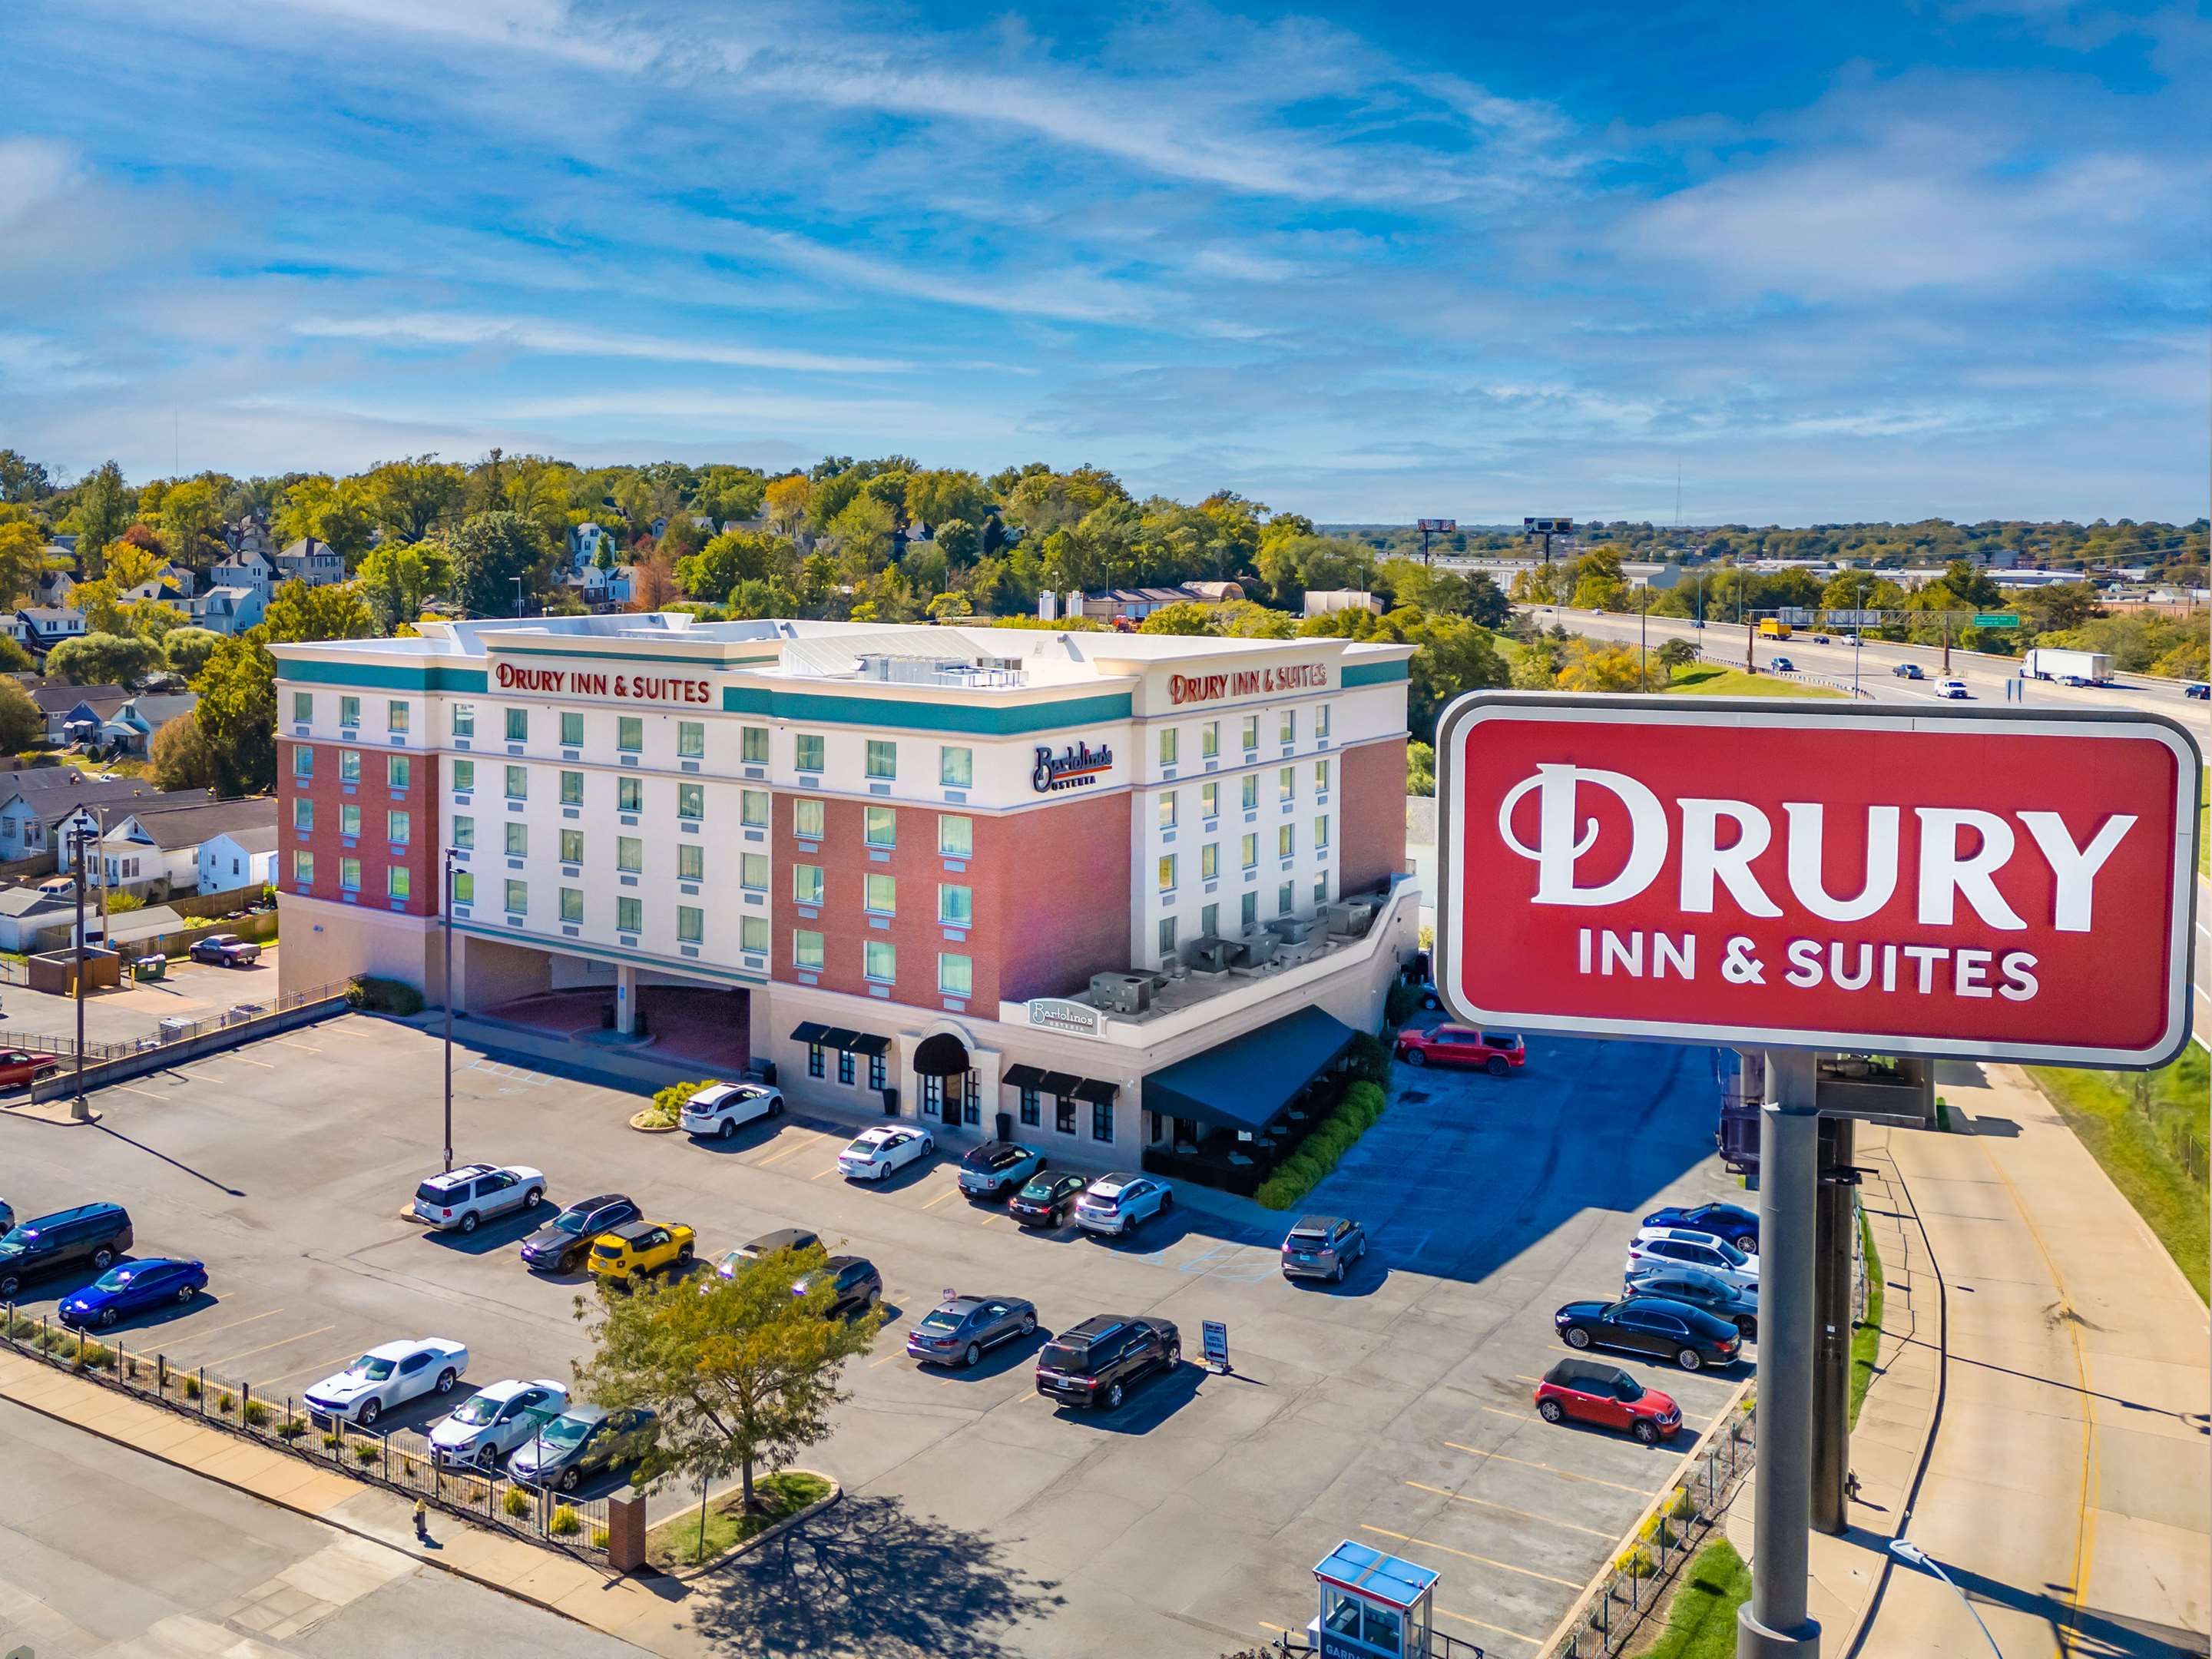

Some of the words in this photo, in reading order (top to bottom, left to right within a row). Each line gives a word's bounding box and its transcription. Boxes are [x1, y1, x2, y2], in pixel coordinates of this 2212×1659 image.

[496, 663, 565, 691] DRURY
[571, 673, 607, 695] INN
[614, 675, 628, 697] &
[632, 676, 710, 704] SUITES
[1167, 674, 1229, 704] DRURY
[1232, 671, 1260, 696] INN
[1263, 668, 1275, 692] &
[1276, 664, 1328, 690] SUITES
[1498, 763, 2139, 933] DRURY
[1579, 929, 1696, 980] INN
[1722, 937, 1767, 985] &
[1785, 939, 2040, 1002] SUITES
